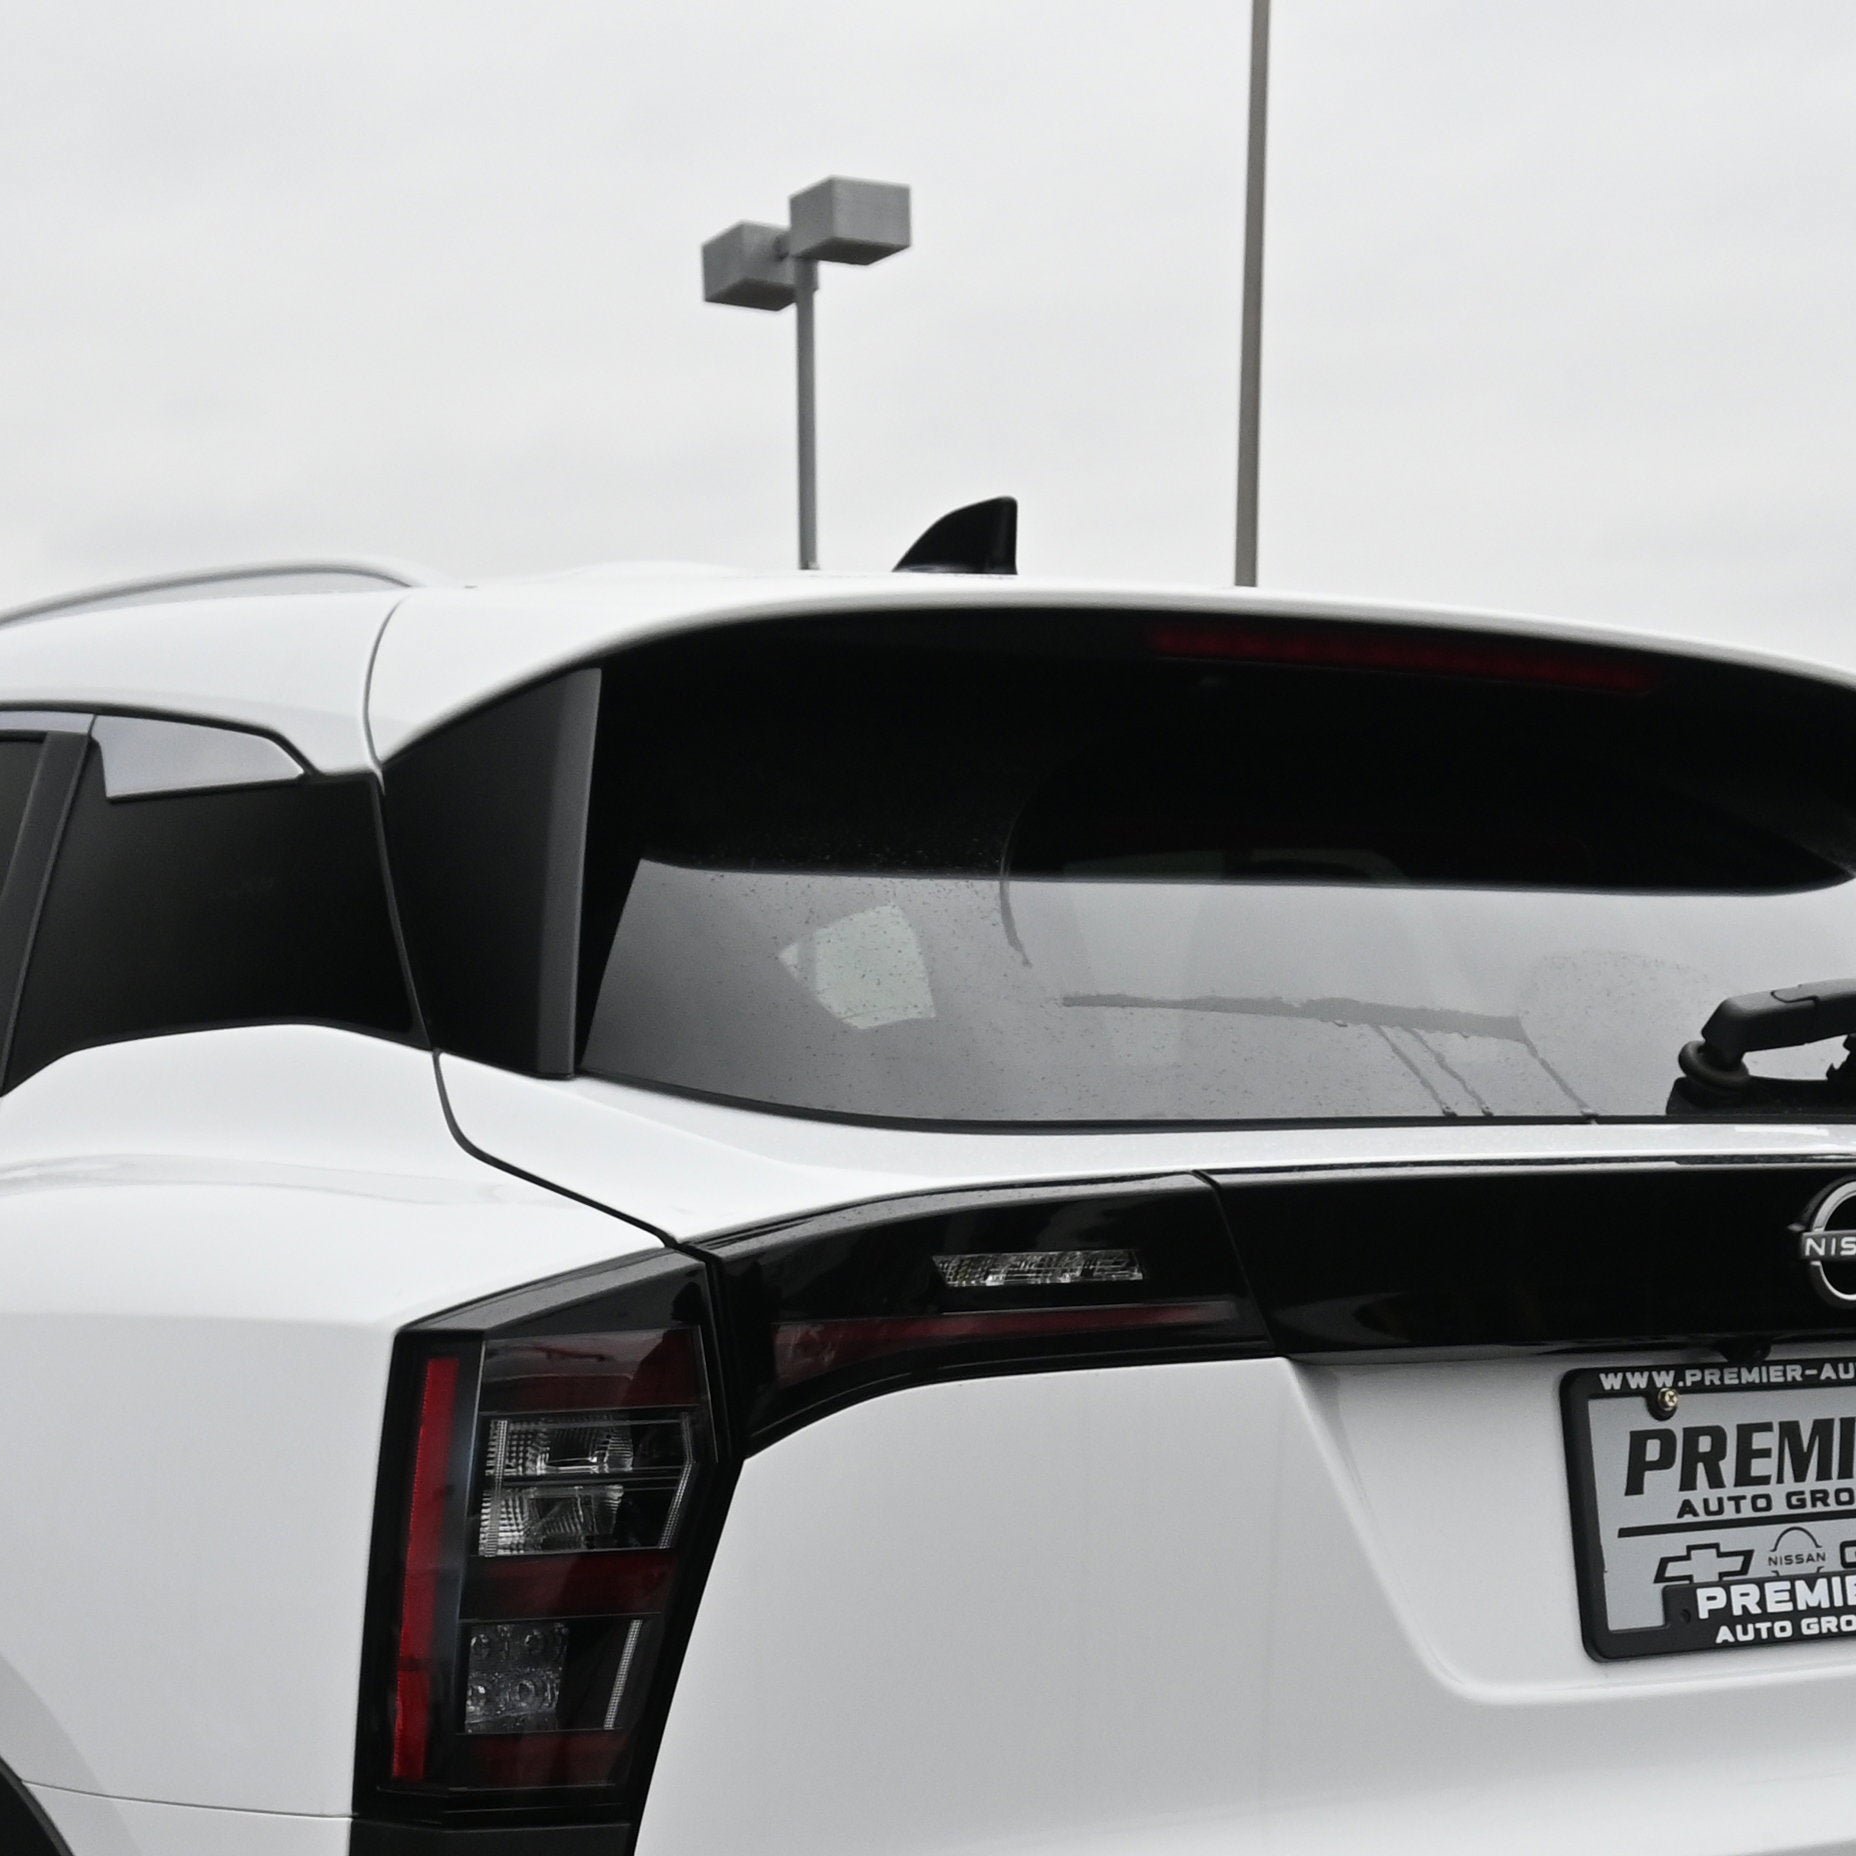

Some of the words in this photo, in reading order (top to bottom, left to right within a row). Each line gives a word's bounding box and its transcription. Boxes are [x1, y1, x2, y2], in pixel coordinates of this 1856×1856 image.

[1676, 1493, 1773, 1519] AUTO
[1767, 1551, 1827, 1567] NISSAN
[1715, 1619, 1793, 1645] AUTO
